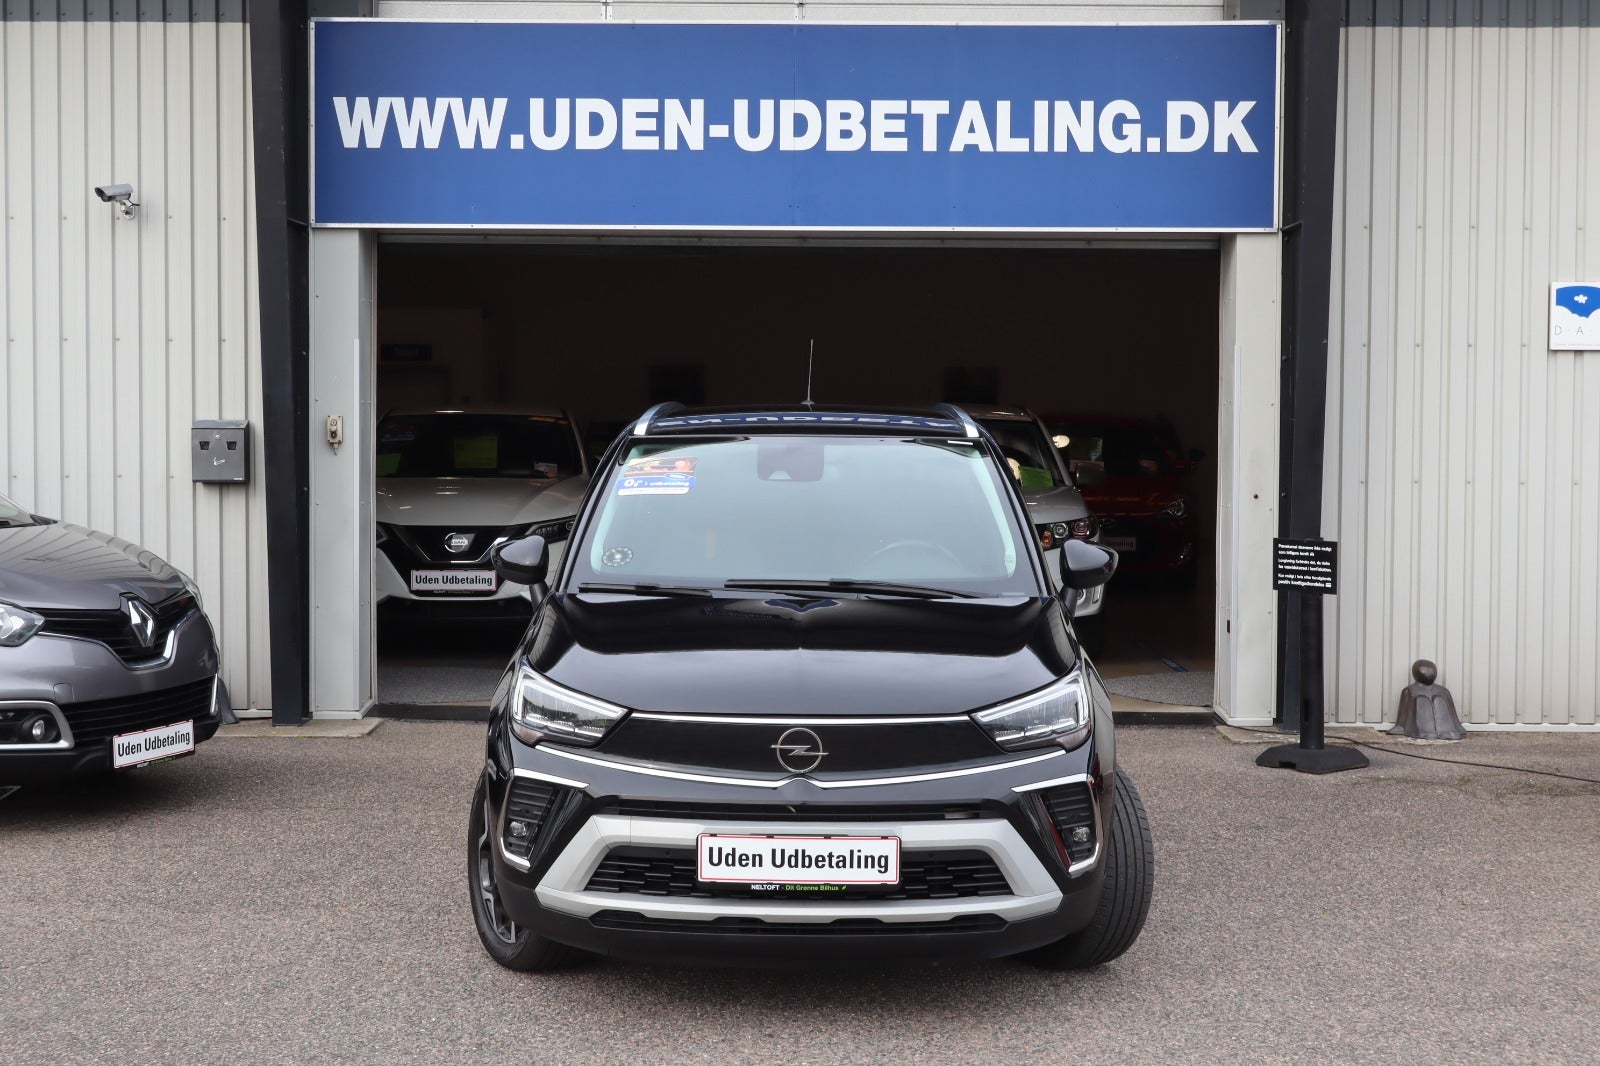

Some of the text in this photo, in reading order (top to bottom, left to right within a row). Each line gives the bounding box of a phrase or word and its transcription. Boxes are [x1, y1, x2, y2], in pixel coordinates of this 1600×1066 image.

[333, 97, 1258, 154] WWW.UDEN-UDBETALING.DK
[415, 574, 493, 587] Uden Udbetaling
[117, 730, 190, 757] Uden Udbetaling
[708, 846, 890, 874] Uden Udbetaling
